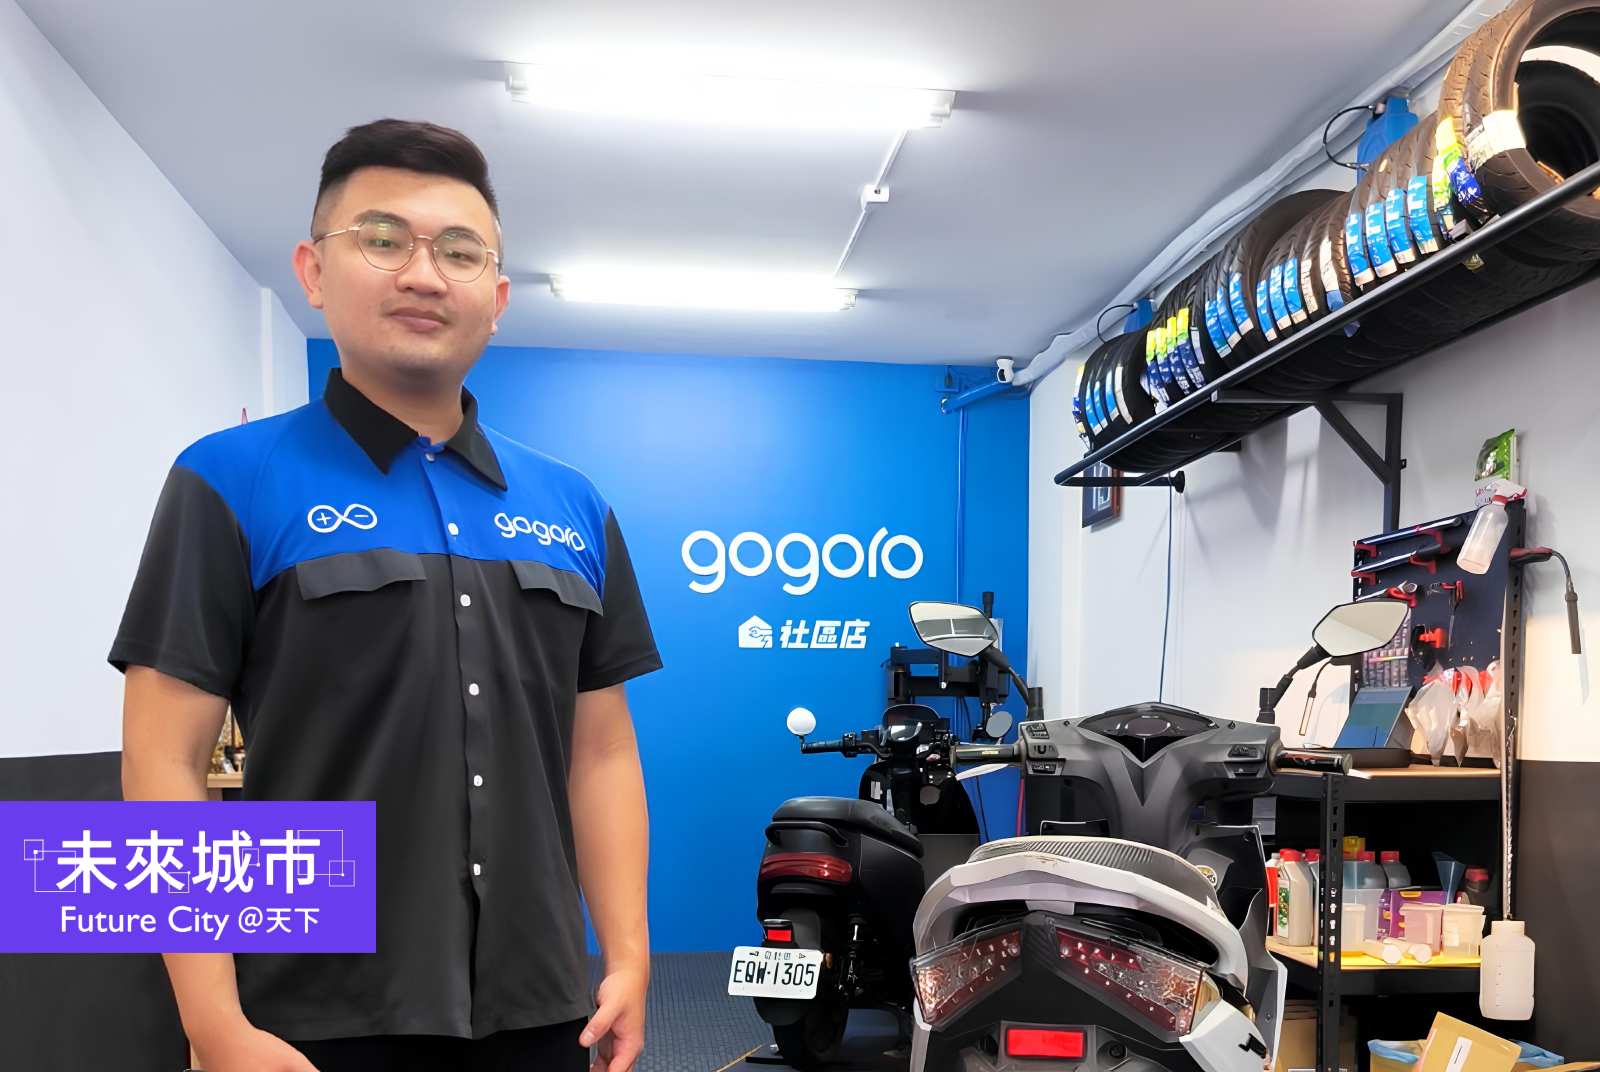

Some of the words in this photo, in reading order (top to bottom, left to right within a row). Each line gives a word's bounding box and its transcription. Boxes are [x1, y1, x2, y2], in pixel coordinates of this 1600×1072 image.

[494, 512, 586, 552] gogoro
[681, 526, 925, 596] gogoro
[779, 619, 871, 649] 社區店
